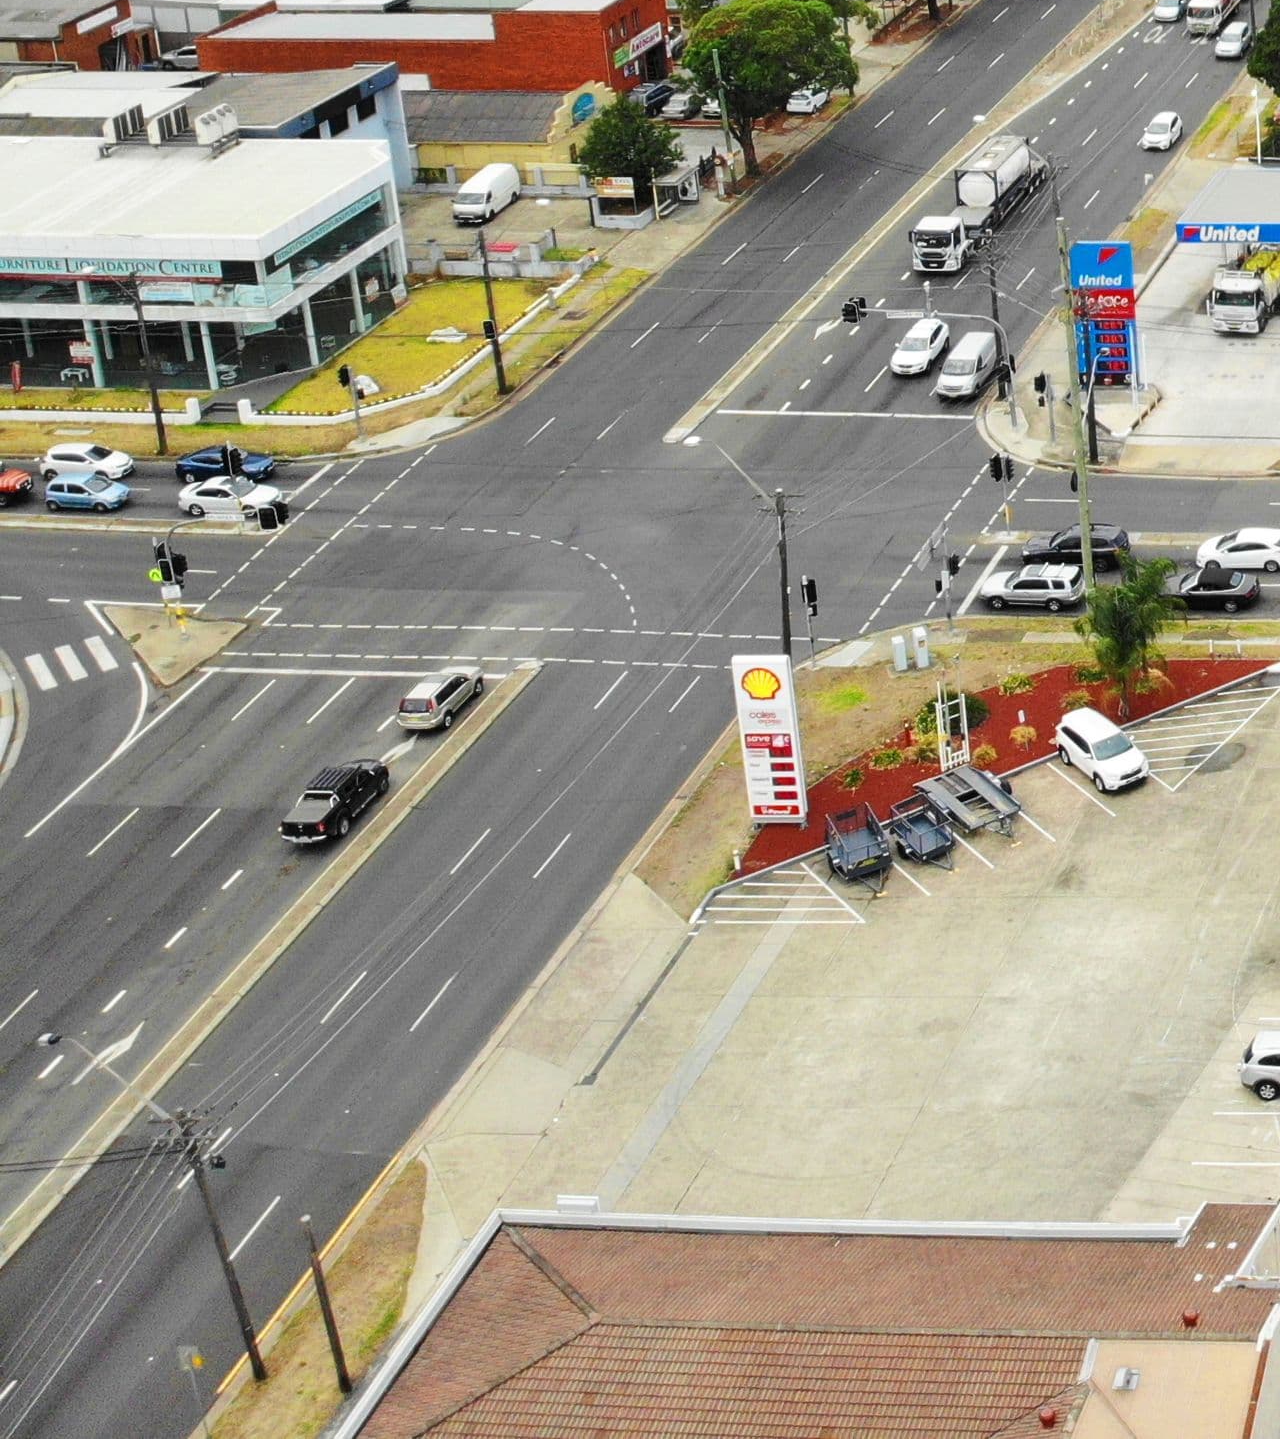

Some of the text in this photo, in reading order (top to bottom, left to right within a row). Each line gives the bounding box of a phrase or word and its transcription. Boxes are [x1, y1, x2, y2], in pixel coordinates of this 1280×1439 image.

[1200, 225, 1260, 242] United
[159, 259, 215, 275] CENTRE
[1079, 274, 1123, 286] United
[1097, 294, 1129, 308] face
